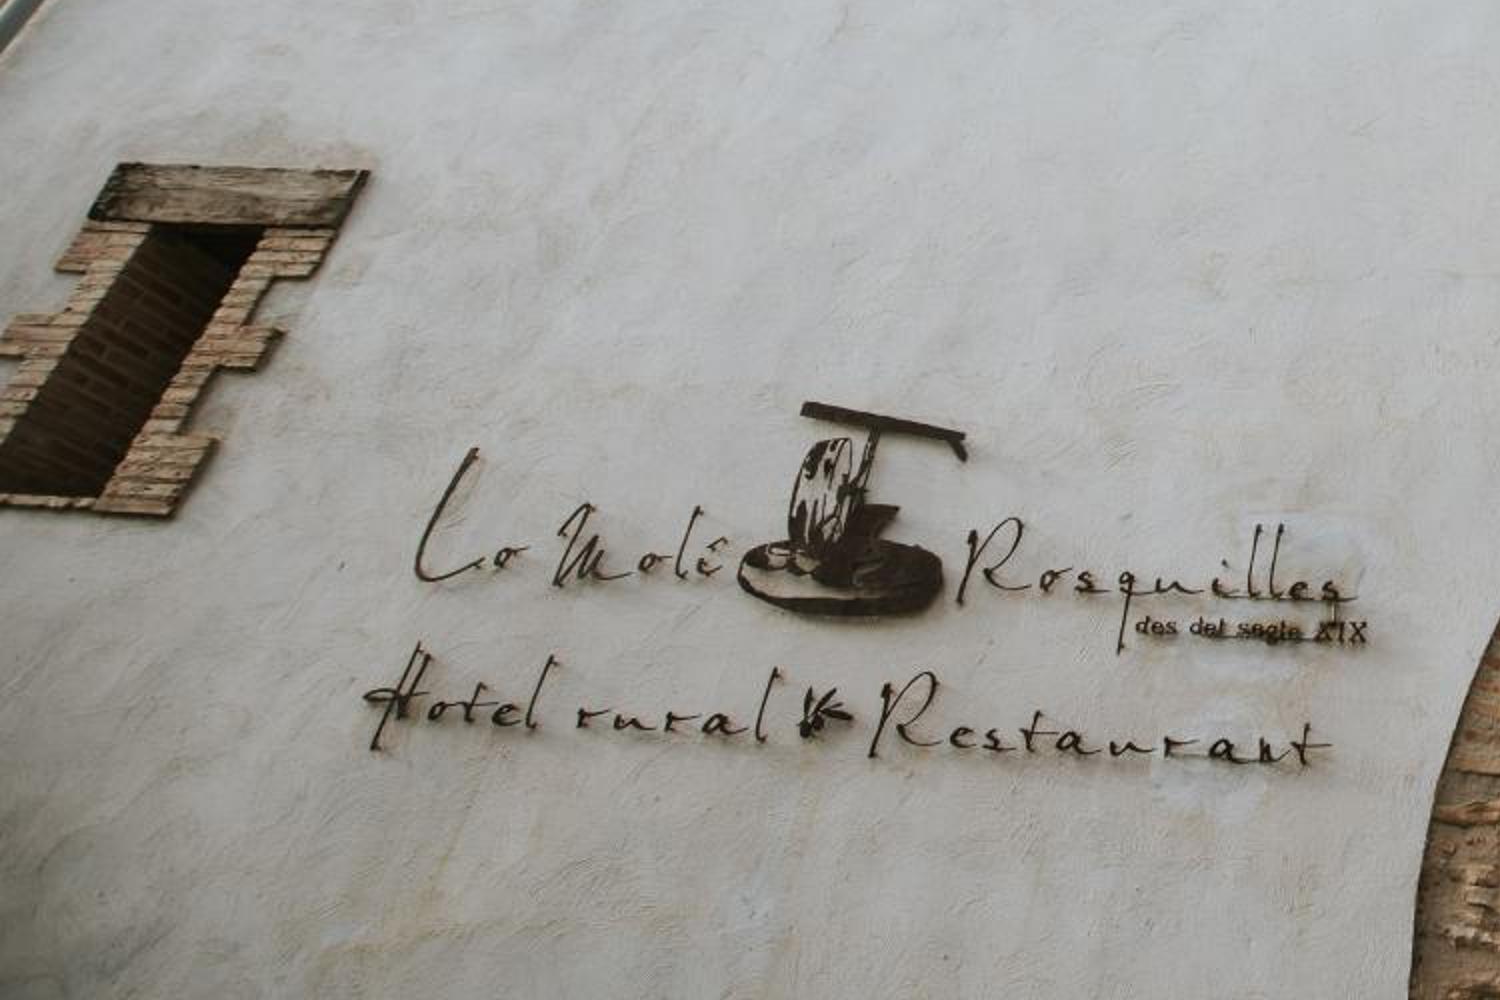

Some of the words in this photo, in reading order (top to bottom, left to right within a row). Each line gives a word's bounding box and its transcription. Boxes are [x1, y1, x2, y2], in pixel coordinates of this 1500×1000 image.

[956, 516, 1357, 655] Rosquilles
[1135, 615, 1178, 636] des
[1188, 616, 1226, 638] del
[1236, 620, 1304, 646] segle
[1312, 620, 1368, 645] XIX
[362, 640, 561, 751] Hotel
[575, 666, 784, 744] rural
[867, 671, 1332, 766] Restaurant
